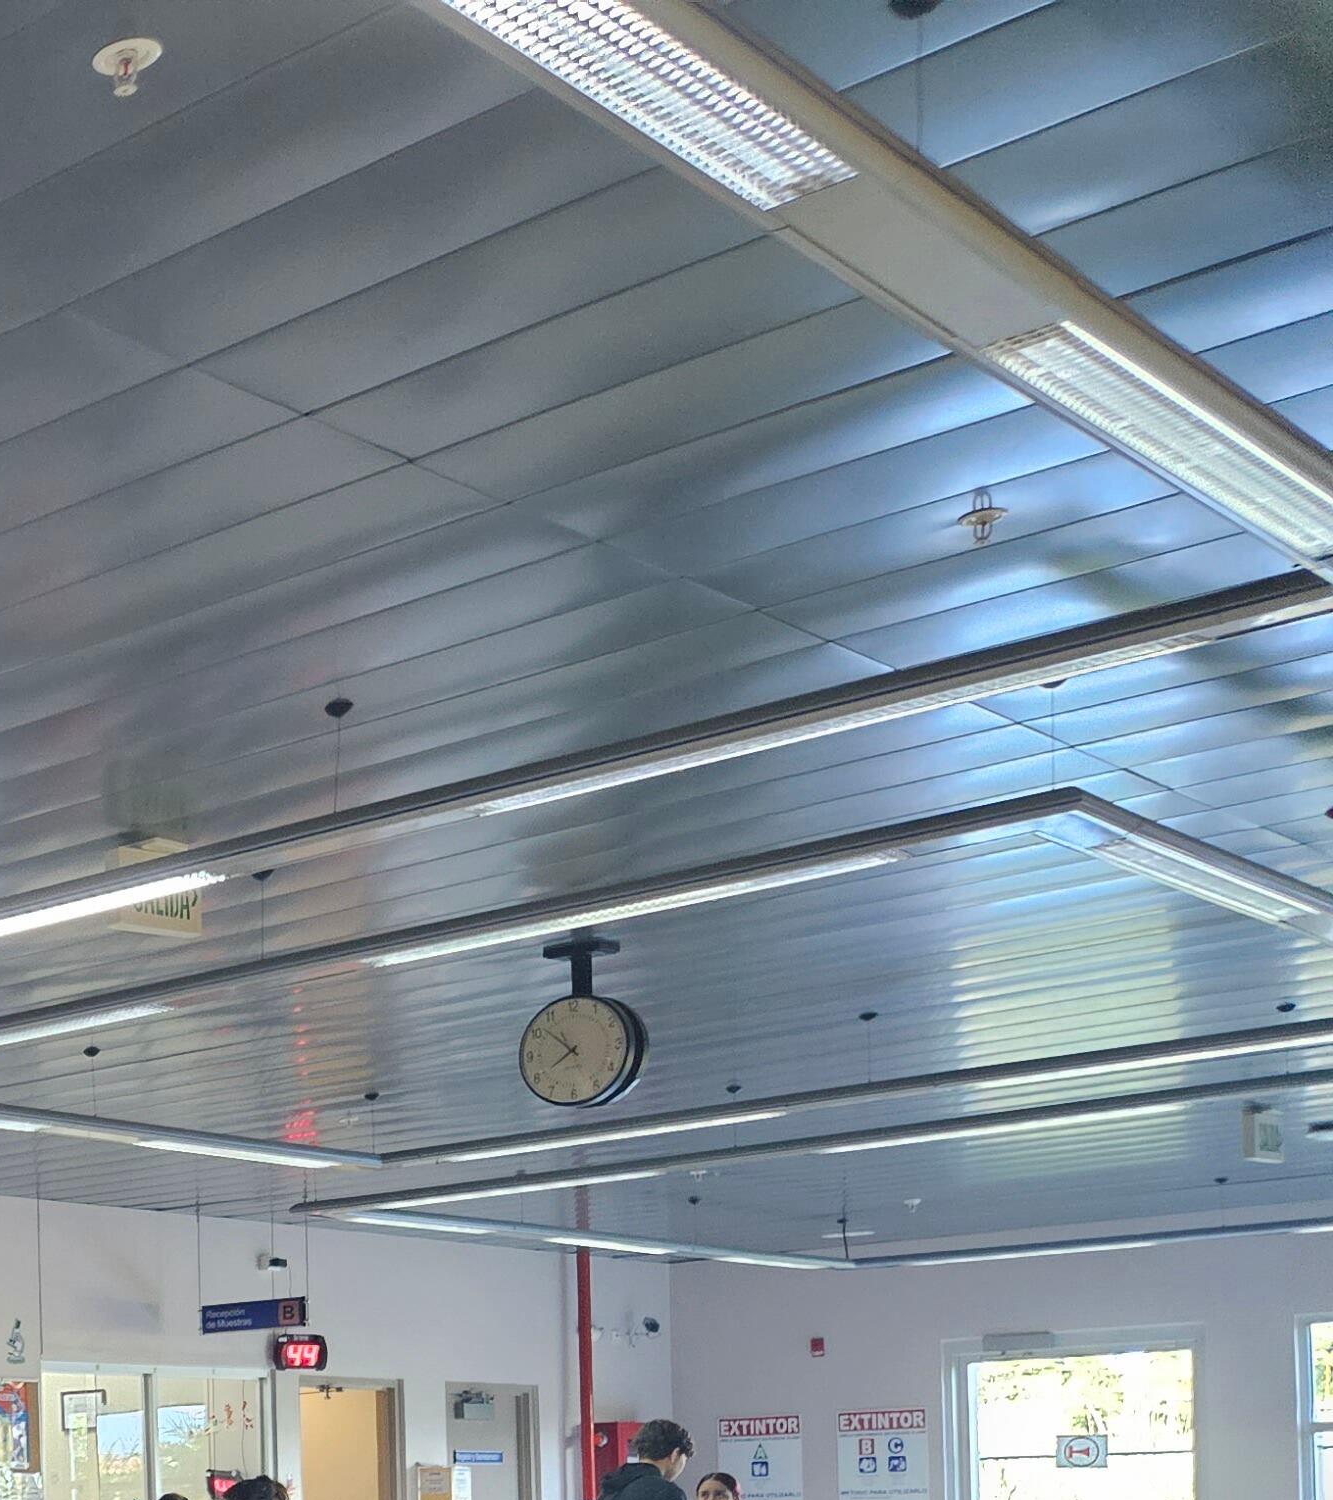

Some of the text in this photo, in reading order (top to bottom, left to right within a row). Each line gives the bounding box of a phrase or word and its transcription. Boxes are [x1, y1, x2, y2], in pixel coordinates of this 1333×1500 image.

[568, 1000, 579, 1012] 12
[548, 1086, 555, 1098] 7
[571, 1088, 578, 1100] 6
[205, 1308, 245, 1320] Recepción
[283, 1304, 294, 1320] B
[205, 1318, 252, 1329] de Muestras
[286, 1344, 320, 1367] 44
[720, 1417, 799, 1436] EXTINTOR
[839, 1411, 925, 1430] EXTINTOR
[860, 1439, 873, 1455] B
[889, 1438, 903, 1454] C
